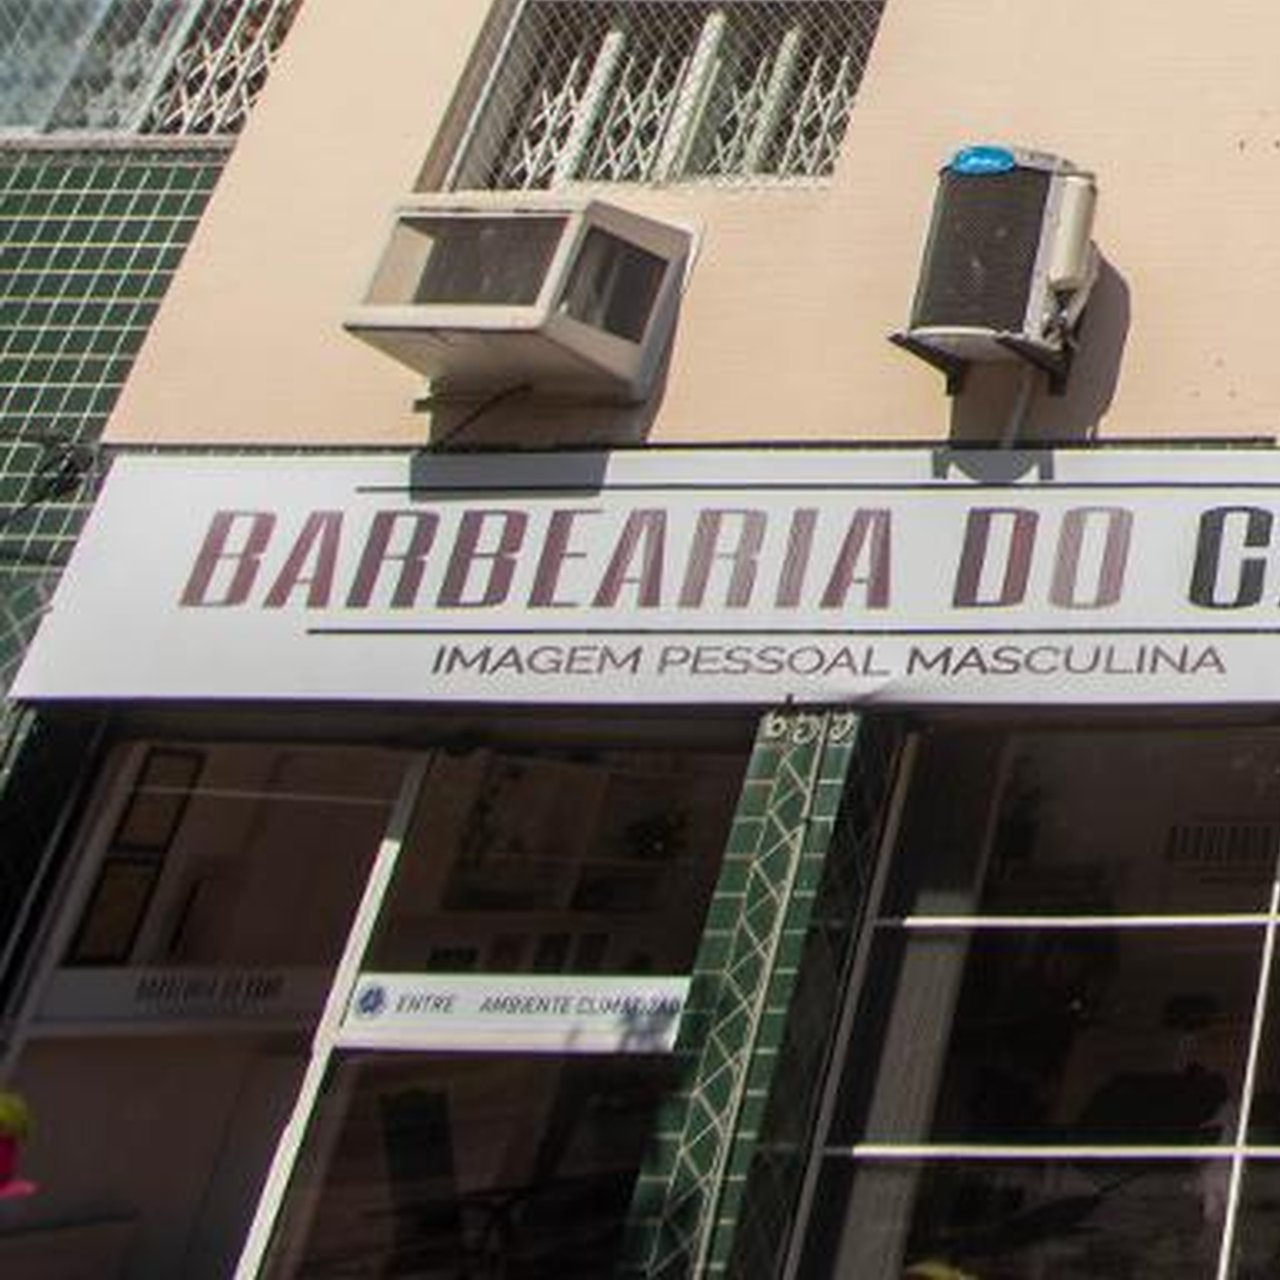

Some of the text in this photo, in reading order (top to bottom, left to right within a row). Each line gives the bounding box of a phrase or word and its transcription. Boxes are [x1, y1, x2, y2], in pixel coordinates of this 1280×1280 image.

[178, 508, 892, 609] BARBEARIA
[951, 506, 1134, 609] DO
[430, 644, 1227, 676] IMAGEM PESSOAL MASCULINA
[395, 995, 454, 1014] ENTRE
